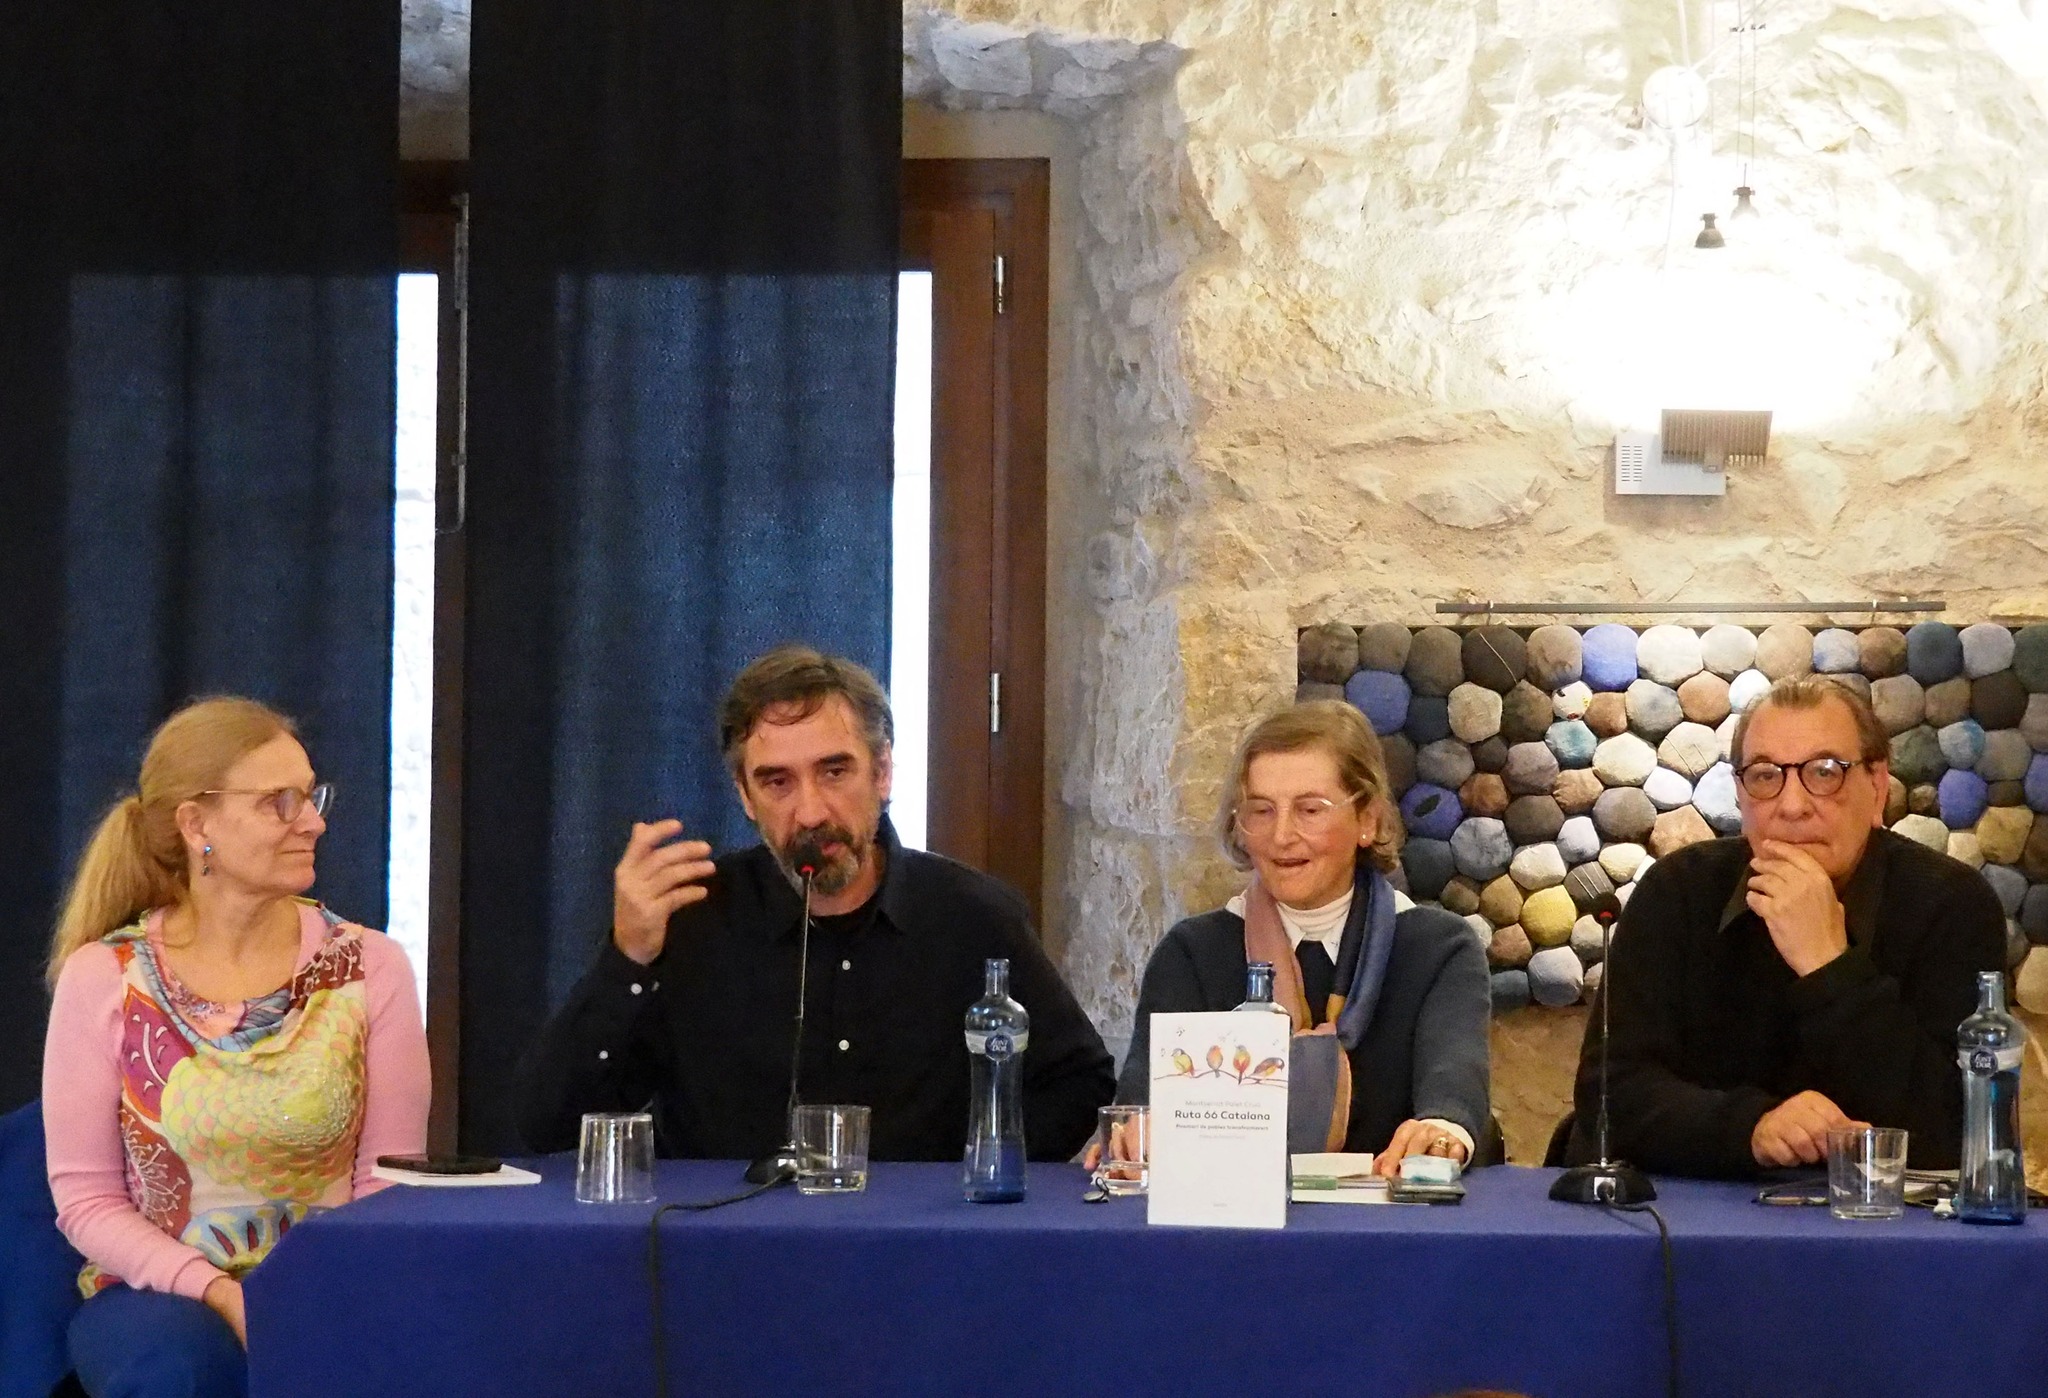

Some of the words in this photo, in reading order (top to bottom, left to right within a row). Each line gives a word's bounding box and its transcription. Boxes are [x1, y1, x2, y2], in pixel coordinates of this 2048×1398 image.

[1175, 1110, 1201, 1119] Ruta
[1204, 1110, 1218, 1119] 66
[1221, 1111, 1271, 1120] Catalana
